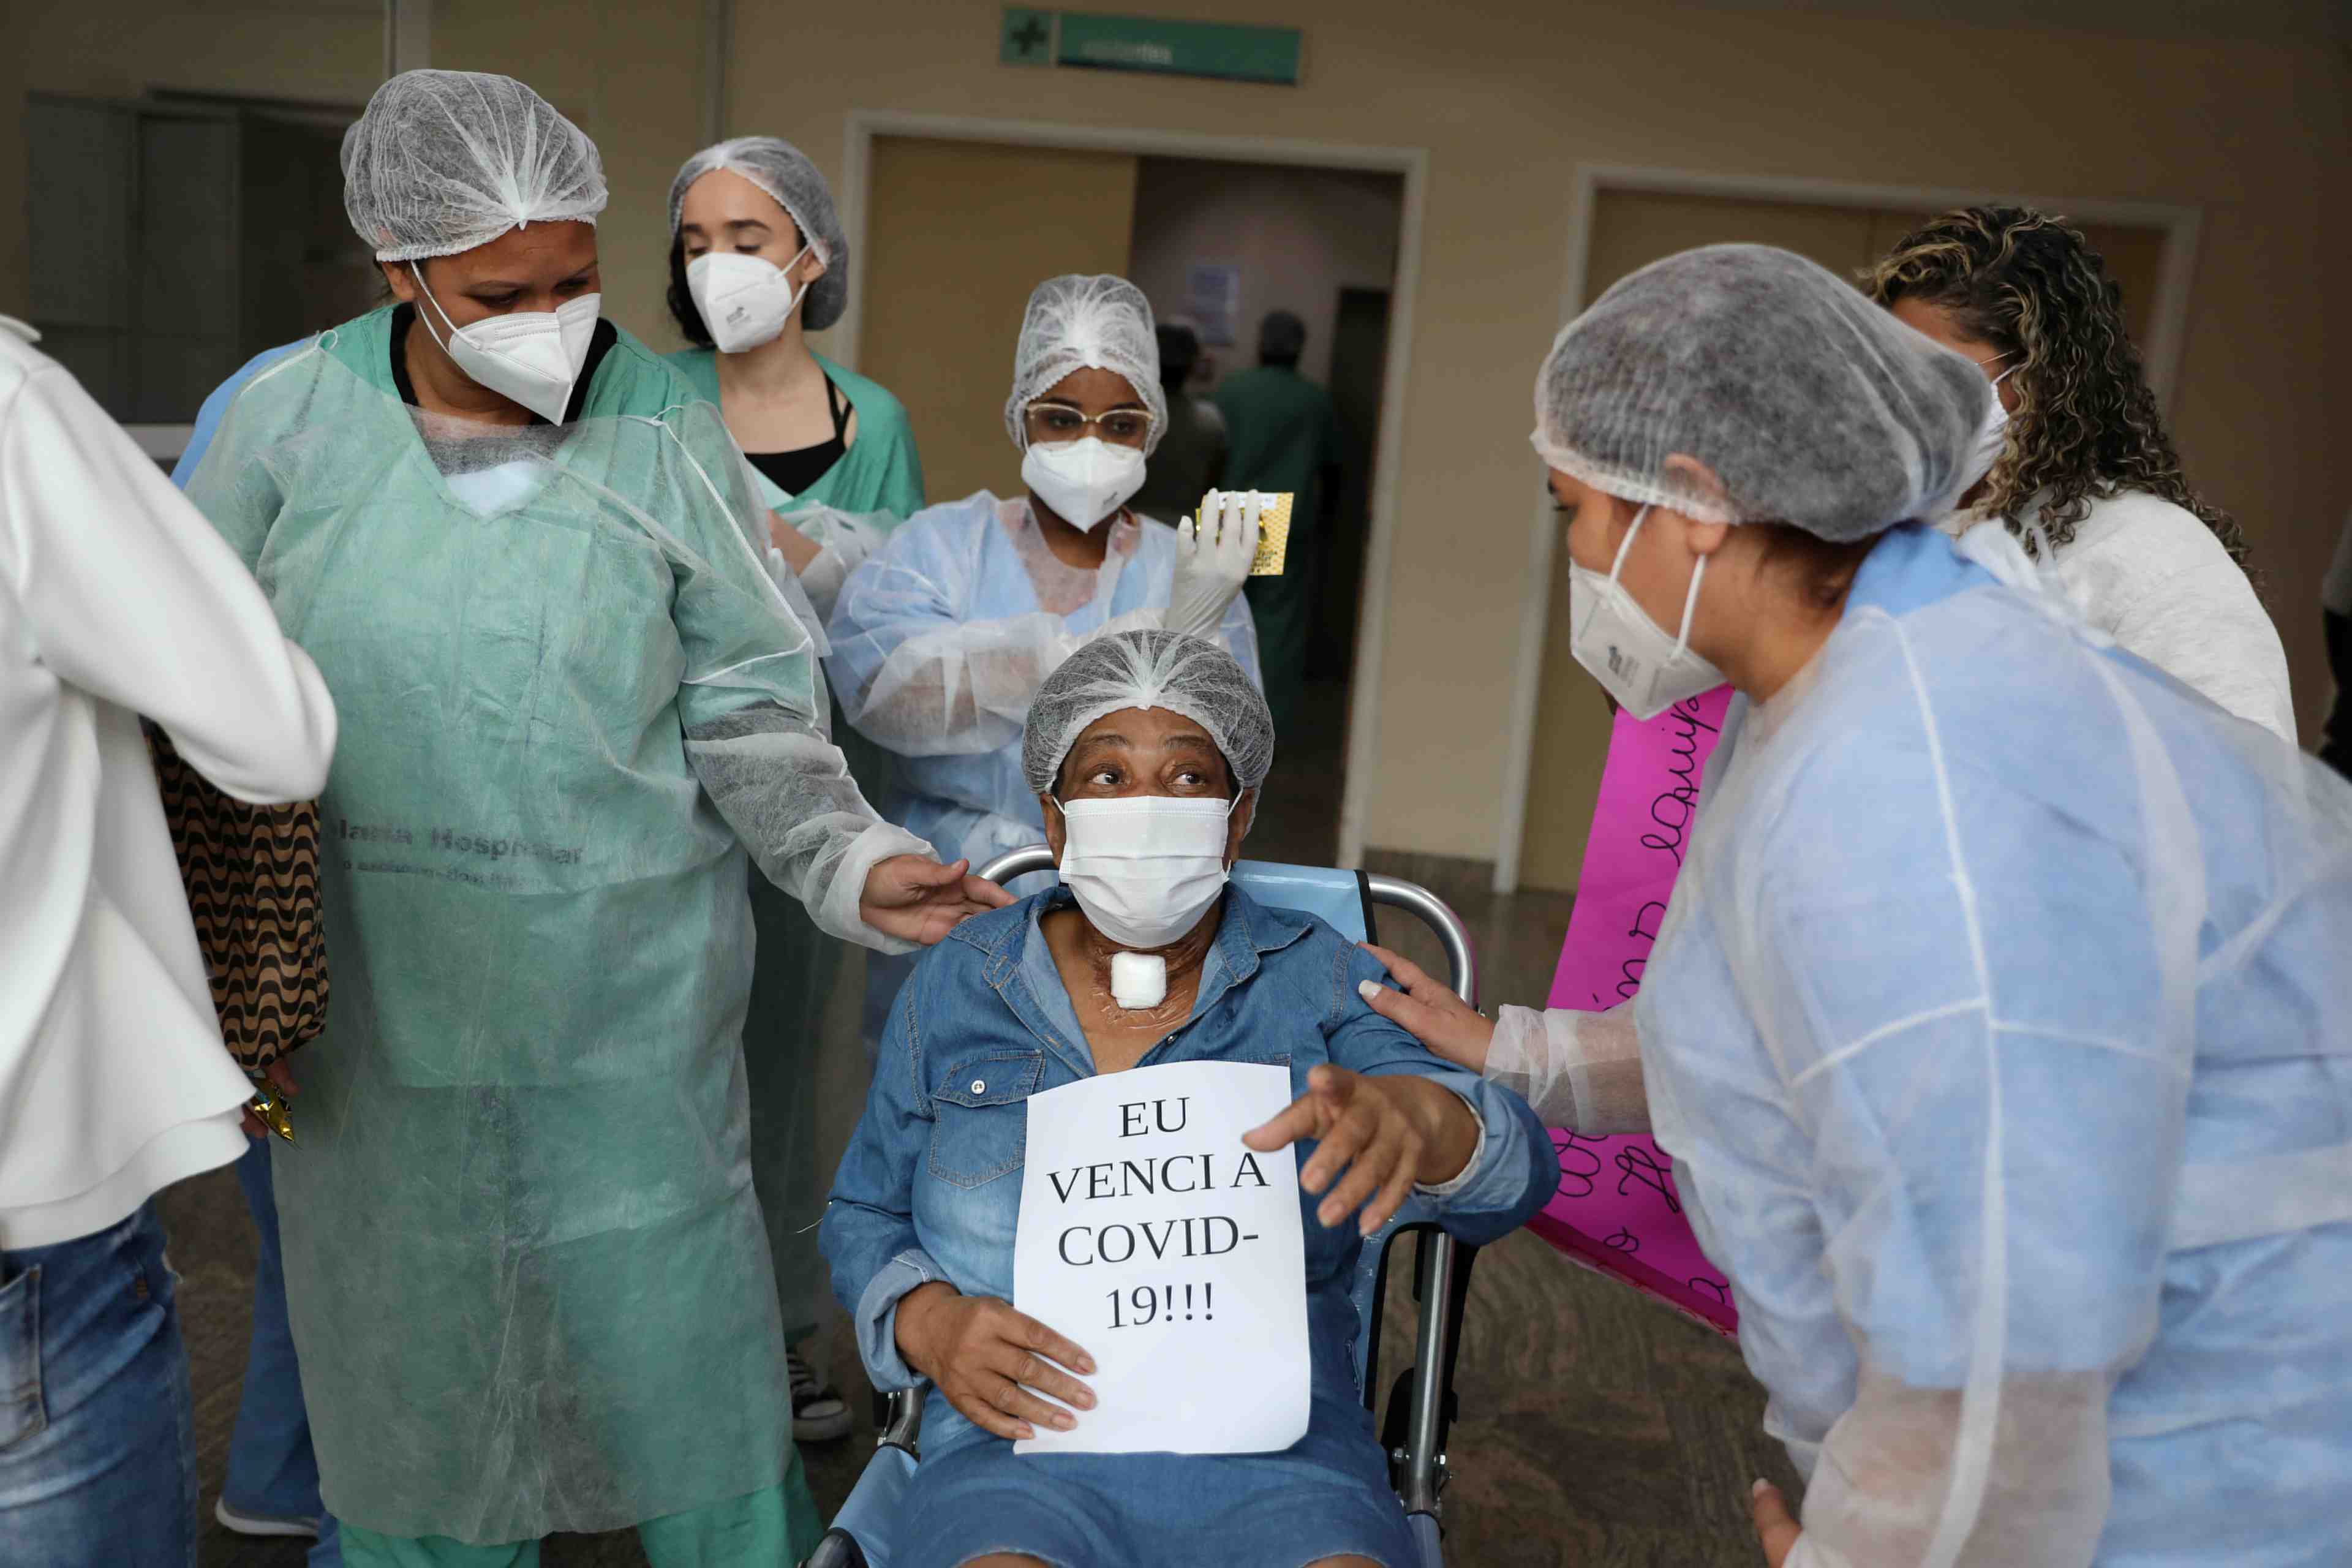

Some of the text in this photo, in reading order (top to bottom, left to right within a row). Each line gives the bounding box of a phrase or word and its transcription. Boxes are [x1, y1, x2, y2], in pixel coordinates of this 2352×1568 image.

[1118, 1097, 1190, 1137] EU
[1046, 1152, 1271, 1204] VENCI A
[1058, 1216, 1259, 1266] COVID-
[1107, 1282, 1213, 1329] 19!!!
